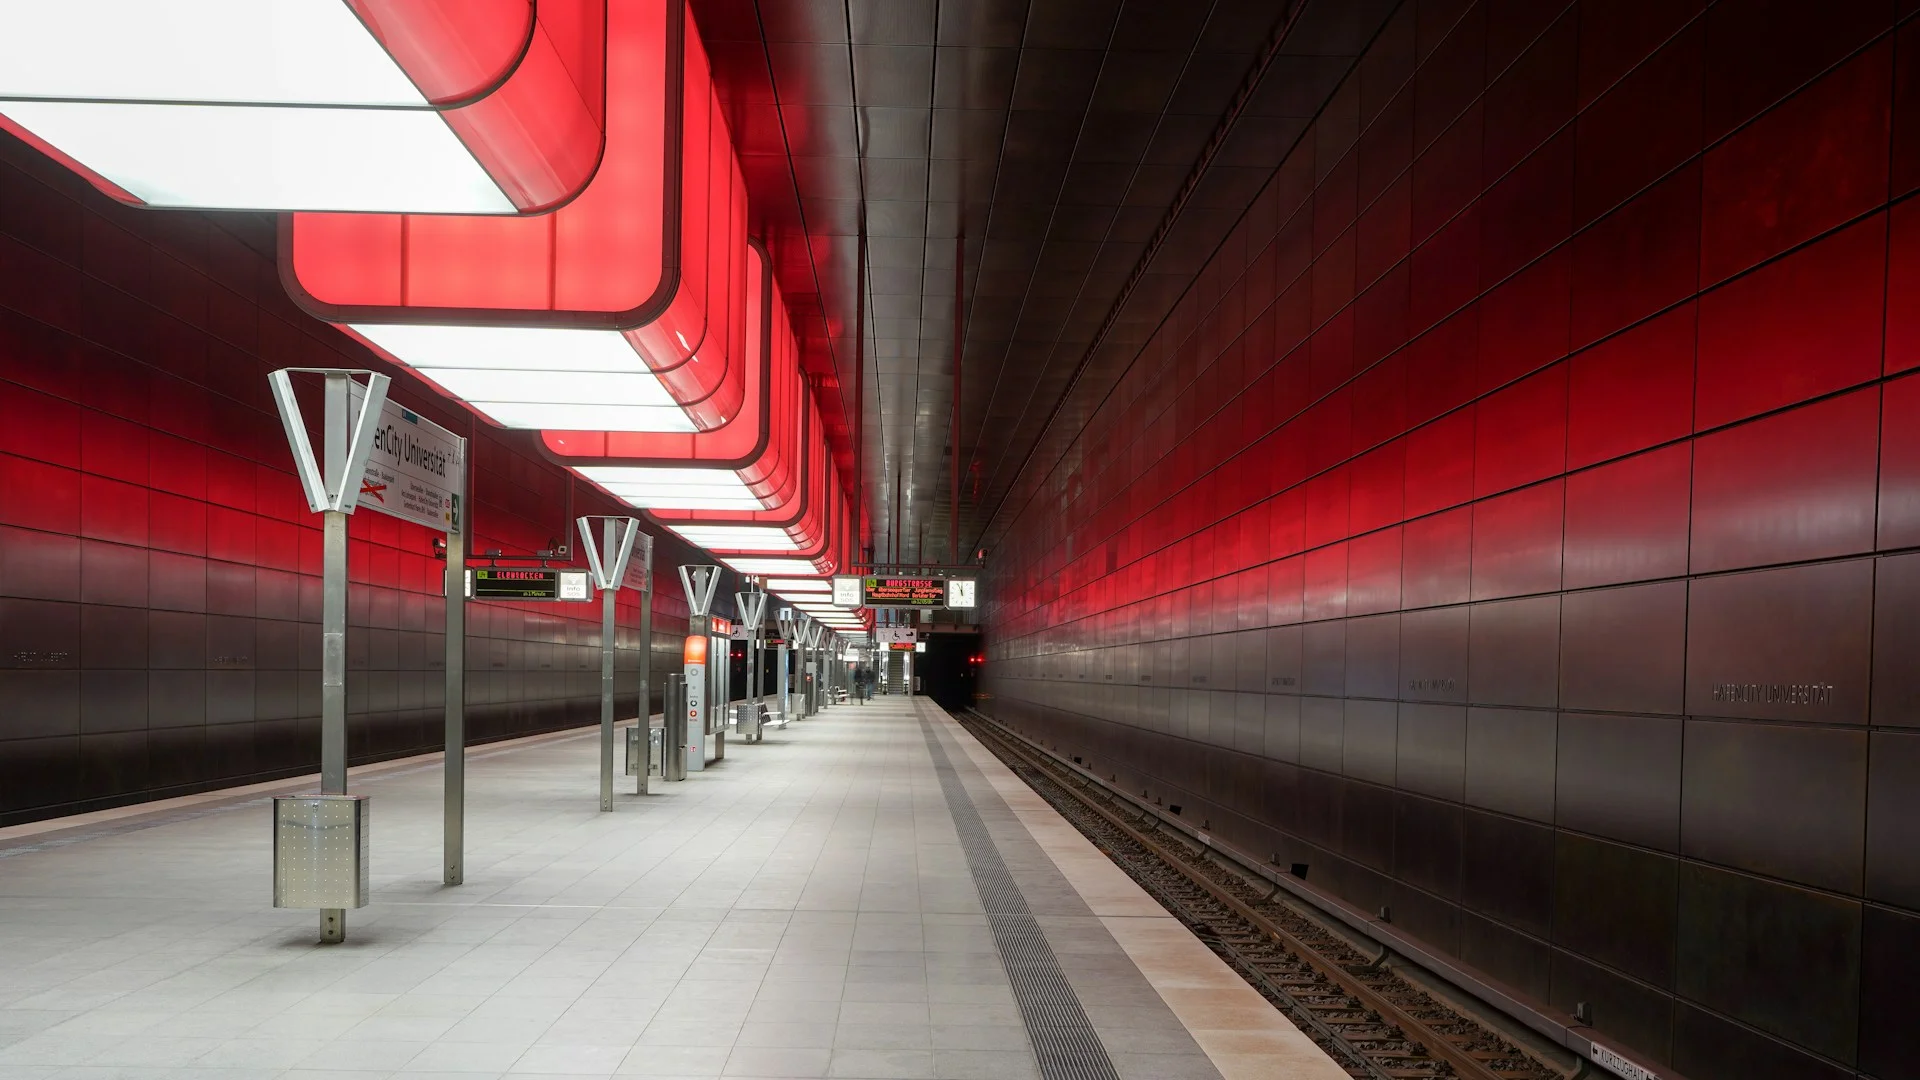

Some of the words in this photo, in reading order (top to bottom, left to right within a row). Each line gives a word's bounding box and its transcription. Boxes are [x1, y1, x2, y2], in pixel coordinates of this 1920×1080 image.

[404, 432, 446, 478] Universität
[885, 579, 933, 588] BURGSTRASSE
[1711, 682, 1763, 703] HAFENCITY
[1765, 682, 1834, 705] UNIVERSITÄT
